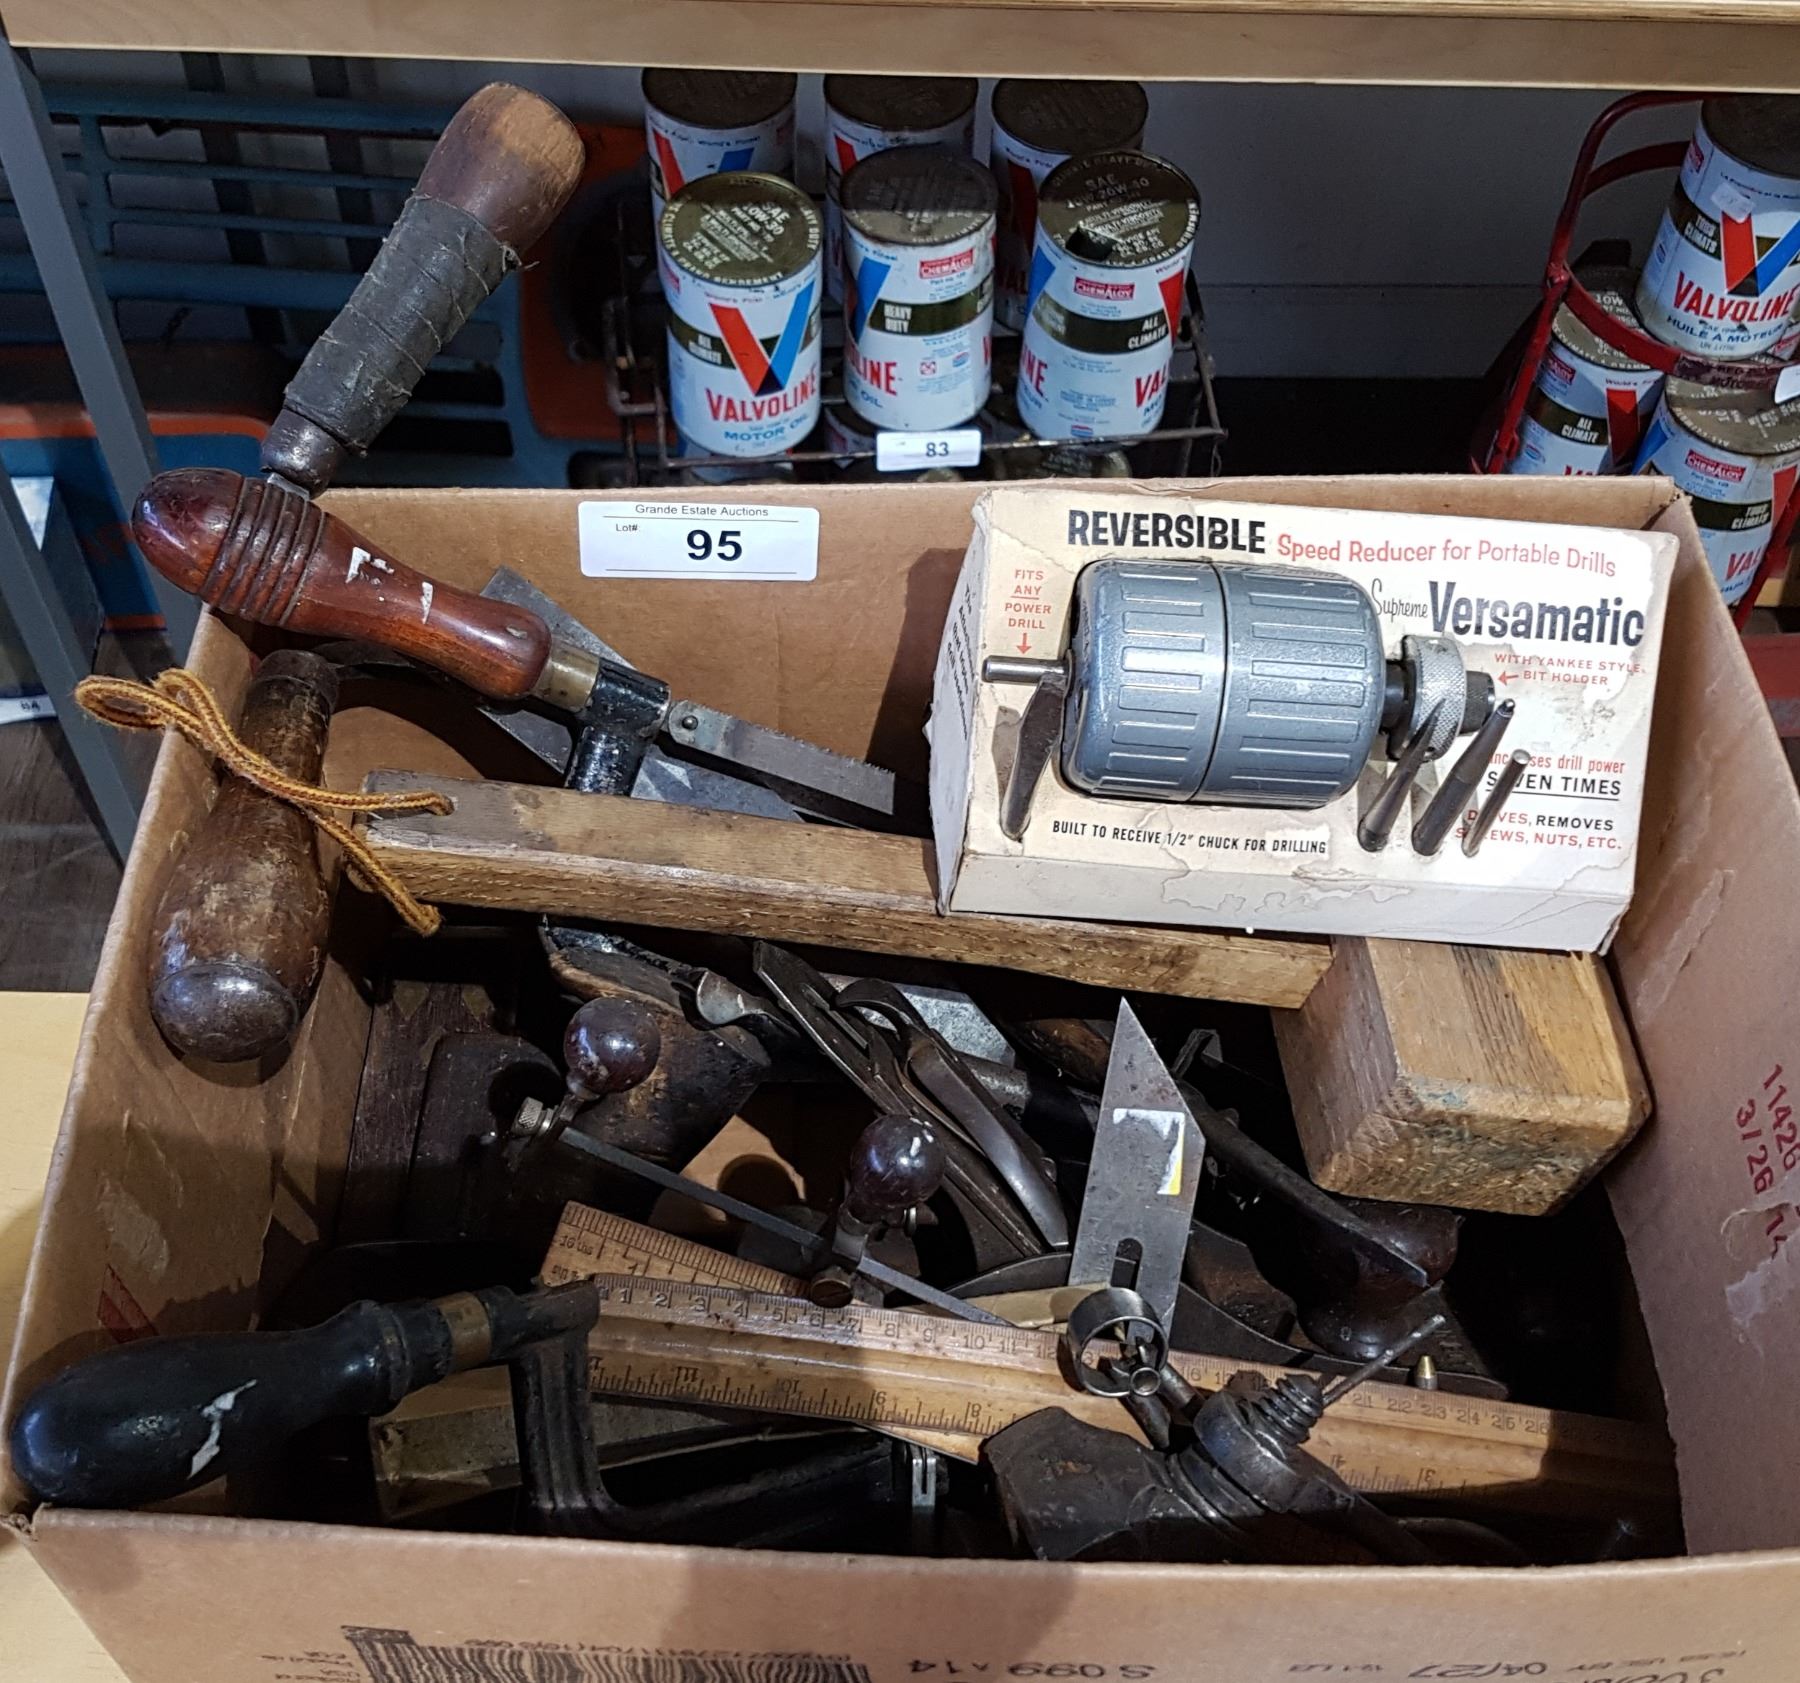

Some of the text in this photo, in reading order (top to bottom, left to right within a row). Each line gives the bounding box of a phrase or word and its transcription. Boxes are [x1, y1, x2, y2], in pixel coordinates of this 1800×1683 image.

[1673, 270, 1800, 323] VALVOLINE
[883, 303, 912, 320] HEAVY
[885, 318, 909, 333] DUTY
[1141, 317, 1159, 332] ALL
[1666, 315, 1709, 339] HUILE
[1726, 323, 1784, 343] MOTEUR
[1127, 325, 1167, 350] CLIMATE
[705, 361, 818, 423] VALVOLINE
[724, 427, 786, 442] MOTOR
[789, 413, 808, 430] OIL
[1576, 416, 1593, 431] ALL
[1561, 423, 1600, 444] CLIMATE
[925, 441, 950, 457] 83
[635, 503, 769, 517] Grande Estate Auctions
[615, 522, 639, 533] Lot#
[686, 529, 743, 562] 95
[1067, 509, 1616, 577] REVERSIBLE Speed Reducer for Portable Drills
[1014, 569, 1044, 581] FITS
[1014, 584, 1042, 597] ANY
[1004, 602, 1052, 615] POWER
[1371, 578, 1645, 647] Supreme Versamatic
[1008, 617, 1046, 630] DRILL
[1495, 653, 1532, 666] WITH
[1538, 655, 1593, 671] YANKEE
[1523, 670, 1609, 686] BIT HOLDER
[1558, 755, 1583, 771] drill
[1588, 758, 1626, 775] power
[1486, 771, 1622, 796] SVEN TIMES
[1468, 810, 1614, 831] DVES, REMOVES
[1052, 820, 1327, 854] BUILT TO RECEIVE 1/2" CHUCK FOR DRILLING
[1456, 828, 1622, 850] SEWS, NUTS, ETC.
[619, 1287, 630, 1304] 1
[655, 1292, 668, 1308] 2
[692, 1297, 707, 1312] 3
[734, 1303, 747, 1318] 4
[772, 1307, 784, 1322] 5
[810, 1312, 822, 1327] 6
[848, 1317, 860, 1331] 7
[885, 1323, 897, 1338] 8
[923, 1328, 935, 1344] 9
[963, 1333, 985, 1350] 10
[1353, 1392, 1374, 1409] 21
[1387, 1397, 1413, 1414] 22
[1421, 1403, 1447, 1420] 23
[1456, 1408, 1479, 1425] 24
[1491, 1413, 1515, 1431] 25
[1525, 1418, 1549, 1435] 26
[971, 1403, 982, 1418] 8
[1425, 1469, 1436, 1482] 3
[907, 1659, 965, 1673] 14
[1006, 1663, 1106, 1680] 099
[1119, 1664, 1156, 1679] S
[1407, 1661, 1548, 1679] 04/27
